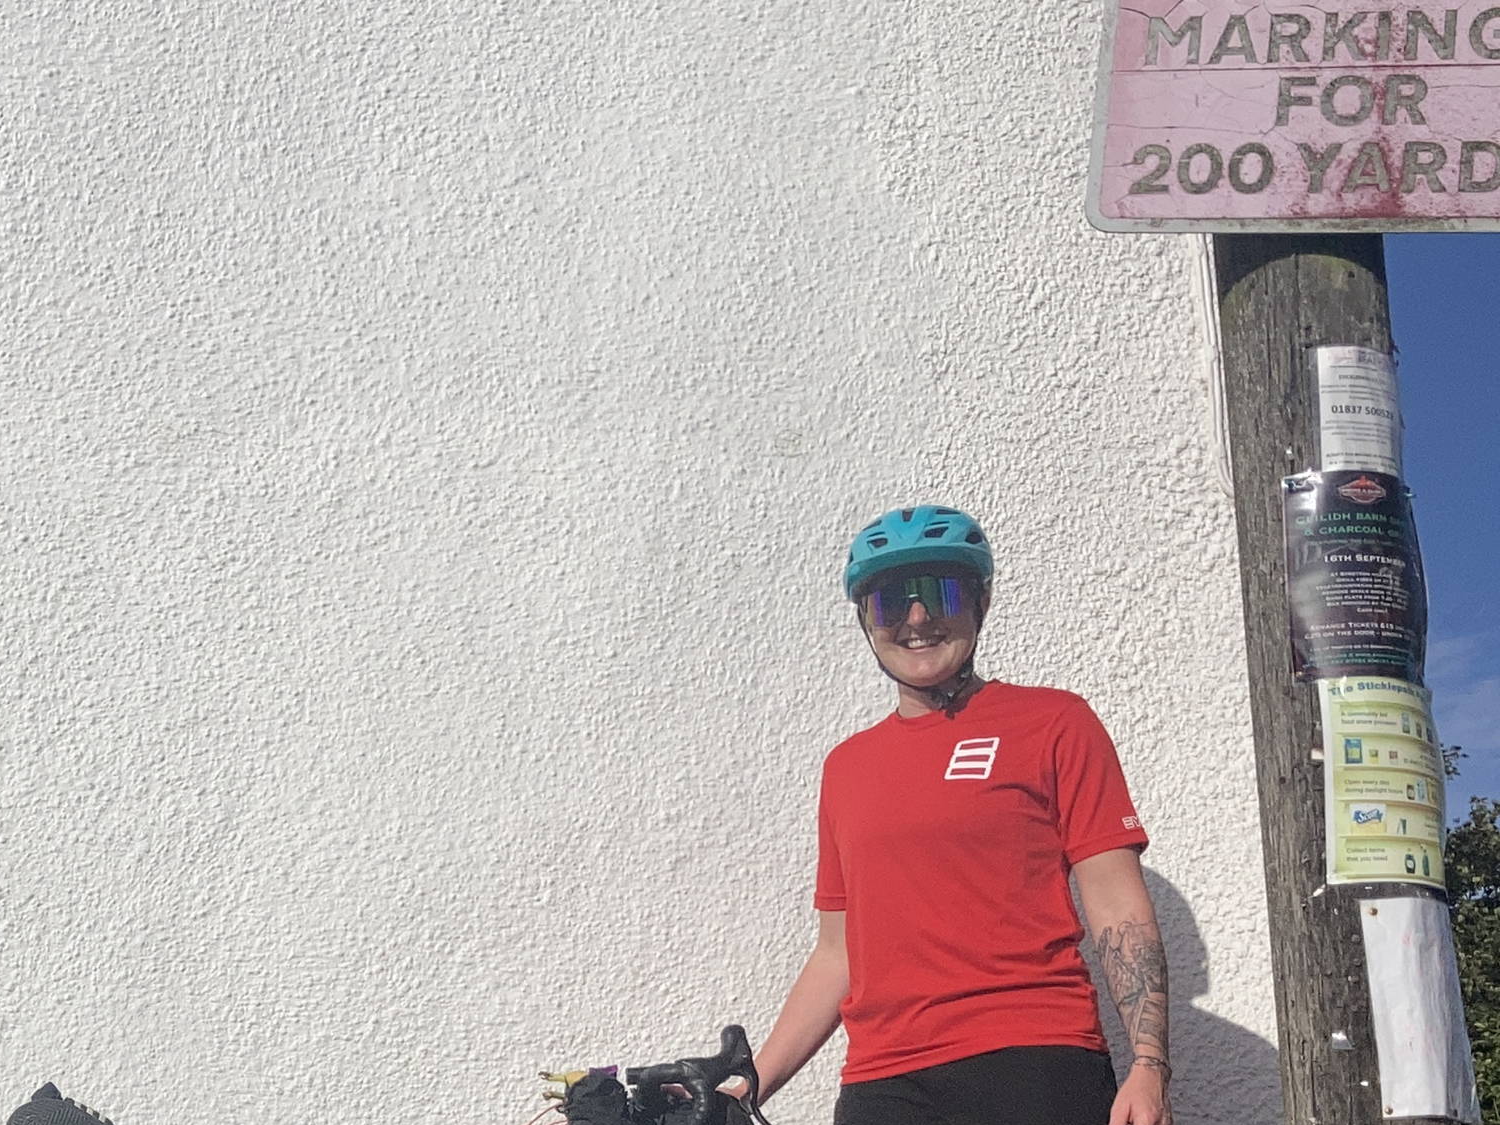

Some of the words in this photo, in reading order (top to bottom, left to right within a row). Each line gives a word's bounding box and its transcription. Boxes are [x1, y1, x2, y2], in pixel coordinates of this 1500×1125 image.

[1145, 7, 1500, 66] MARKING
[1275, 73, 1430, 128] FOR
[1127, 141, 1275, 195] 200
[1296, 140, 1500, 195] YARD
[1331, 404, 1363, 414] 01837
[1320, 525, 1385, 536] CHARCOAL
